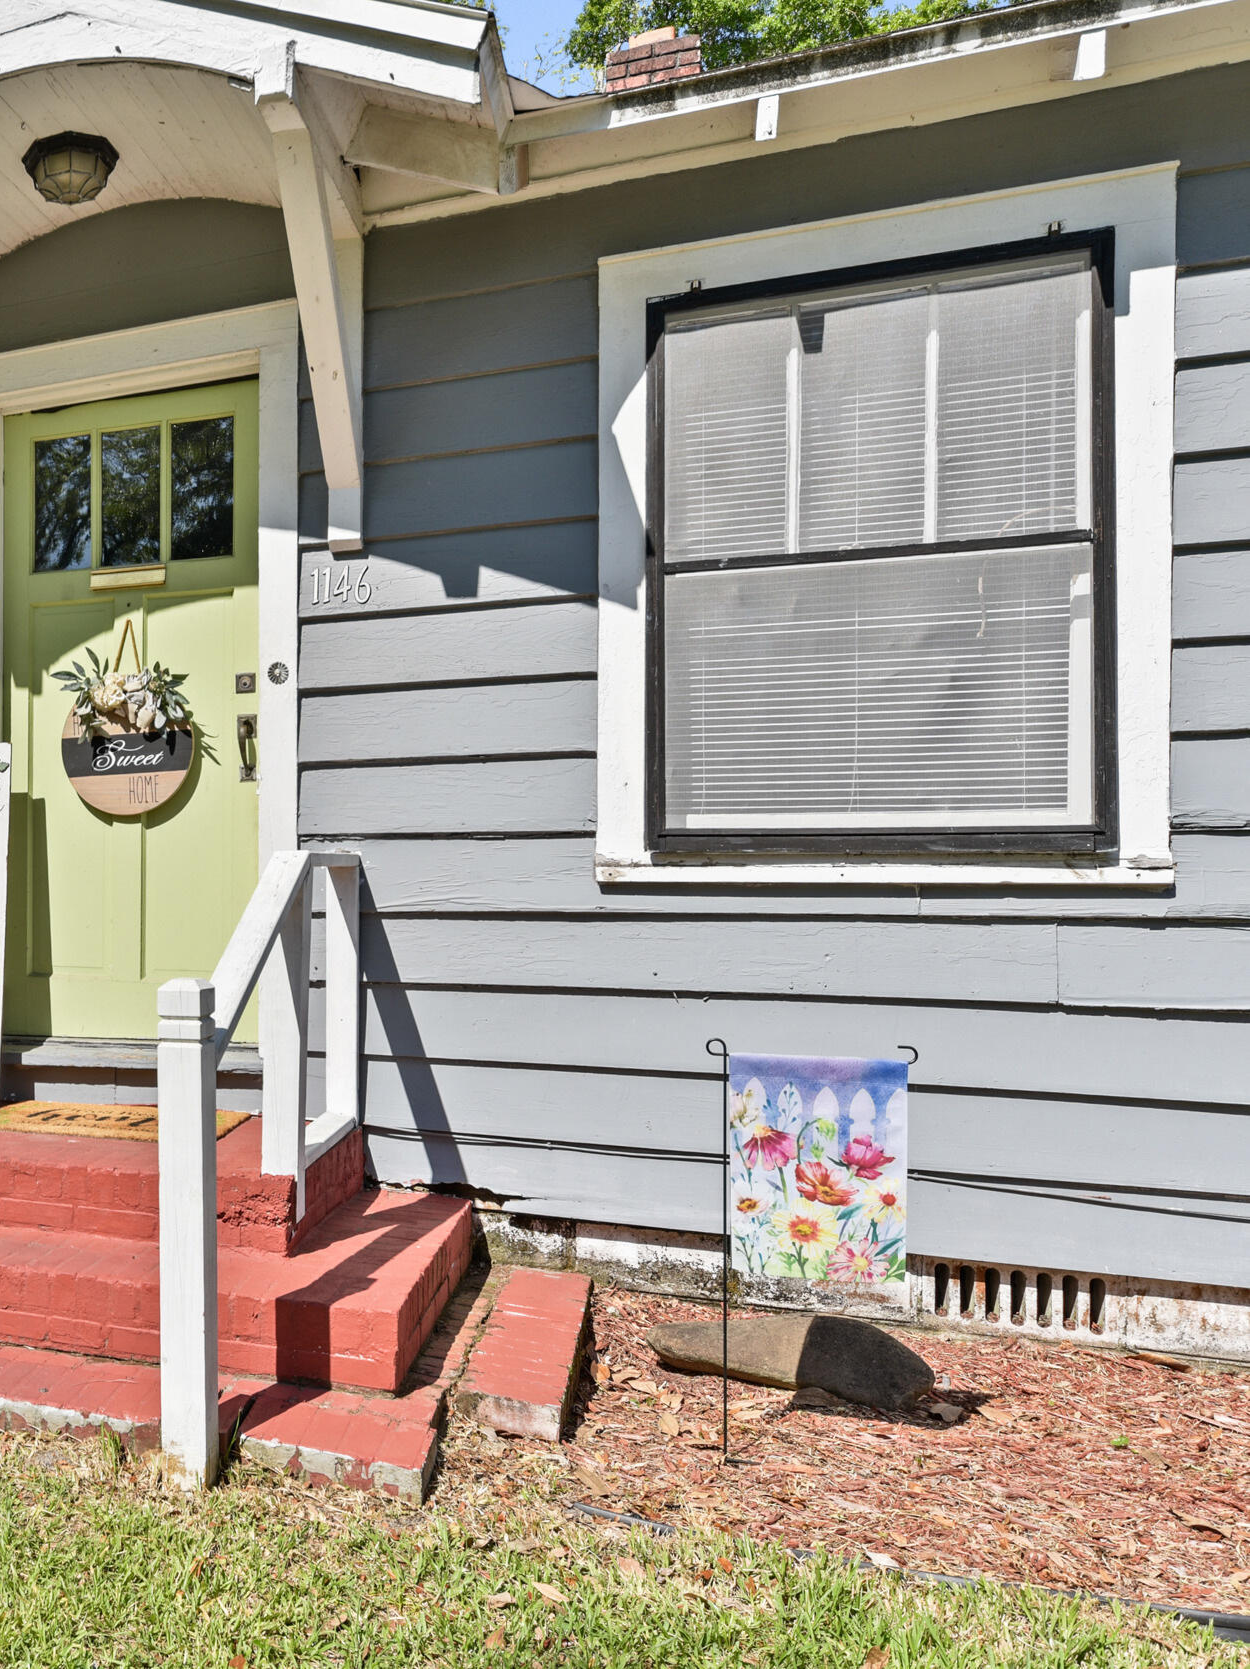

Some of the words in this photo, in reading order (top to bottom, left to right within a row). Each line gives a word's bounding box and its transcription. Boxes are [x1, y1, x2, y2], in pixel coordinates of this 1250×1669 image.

[310, 565, 372, 605] 1146
[91, 739, 165, 772] Sweet
[129, 775, 159, 804] HOME
